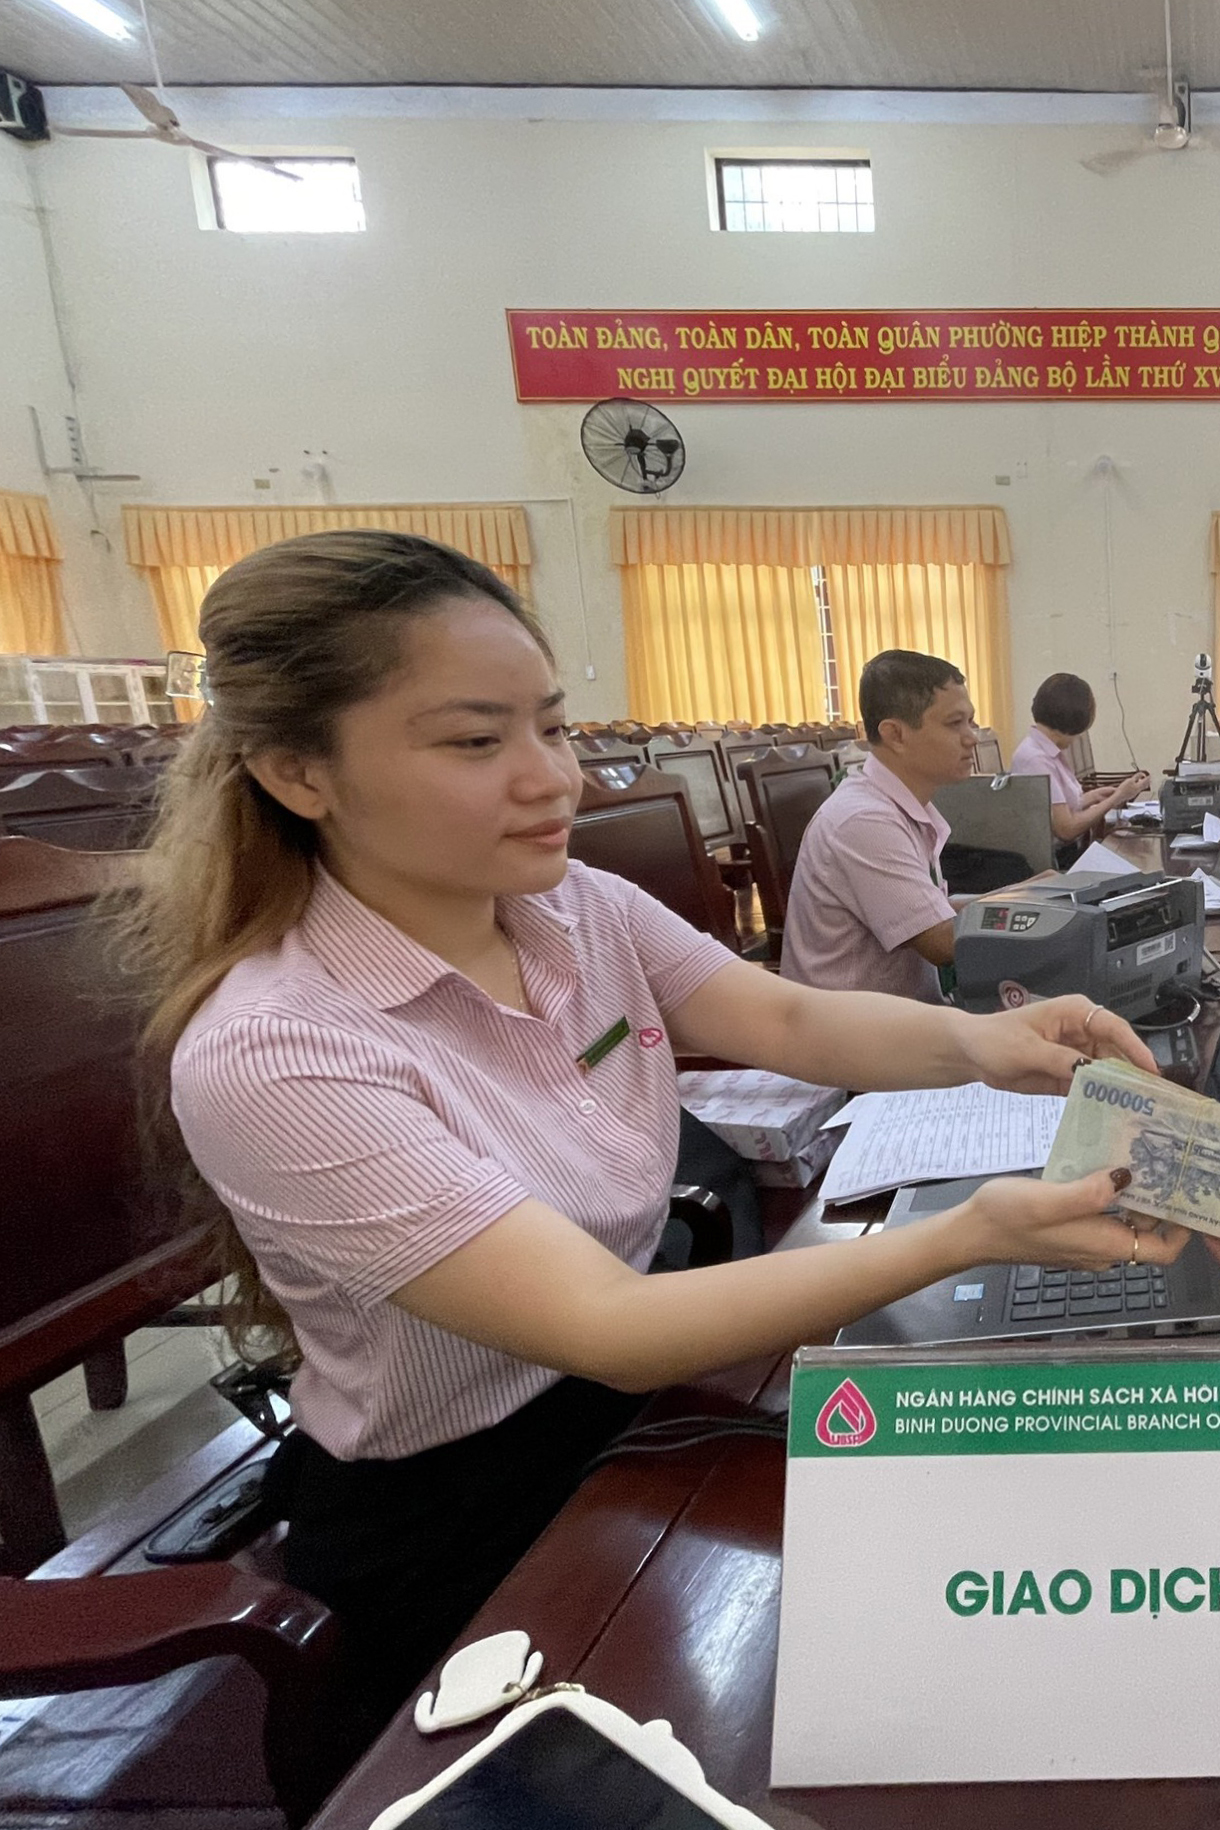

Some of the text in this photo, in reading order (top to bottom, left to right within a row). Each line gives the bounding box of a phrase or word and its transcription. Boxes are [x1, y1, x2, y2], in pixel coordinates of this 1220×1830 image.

[526, 320, 588, 349] TOÀN
[595, 318, 669, 352] ĐẢNG,
[675, 320, 737, 349] TOÀN
[744, 320, 800, 352] DÂN,
[807, 320, 870, 349] TOÀN
[877, 320, 941, 355] QUÂN
[948, 319, 1044, 348] PHƯỜNG
[1050, 319, 1108, 353] HIỆP
[1114, 319, 1196, 348] THÀNH
[616, 367, 675, 395] NGHỊ
[682, 357, 760, 396] QUYẾT
[766, 367, 809, 394] ĐẠI
[815, 361, 858, 395] HỘI
[864, 366, 906, 394] ĐẠI
[912, 354, 968, 389] BIỂU
[974, 358, 1040, 389] ĐẢNG
[1046, 360, 1078, 393] BỘ
[1085, 354, 1131, 388] LẦN
[1137, 360, 1187, 388] THỨ
[1083, 1080, 1156, 1116] 500000
[958, 1386, 1017, 1407] HÀNG
[1022, 1386, 1084, 1406] CHÍNH
[1089, 1386, 1144, 1405] SÁCH
[895, 1418, 936, 1434] BINH
[941, 1416, 1009, 1433] DUONG
[1014, 1414, 1122, 1432] PROVINCIAL
[1127, 1413, 1200, 1430] BRANCH
[945, 1568, 1093, 1617] GIAO
